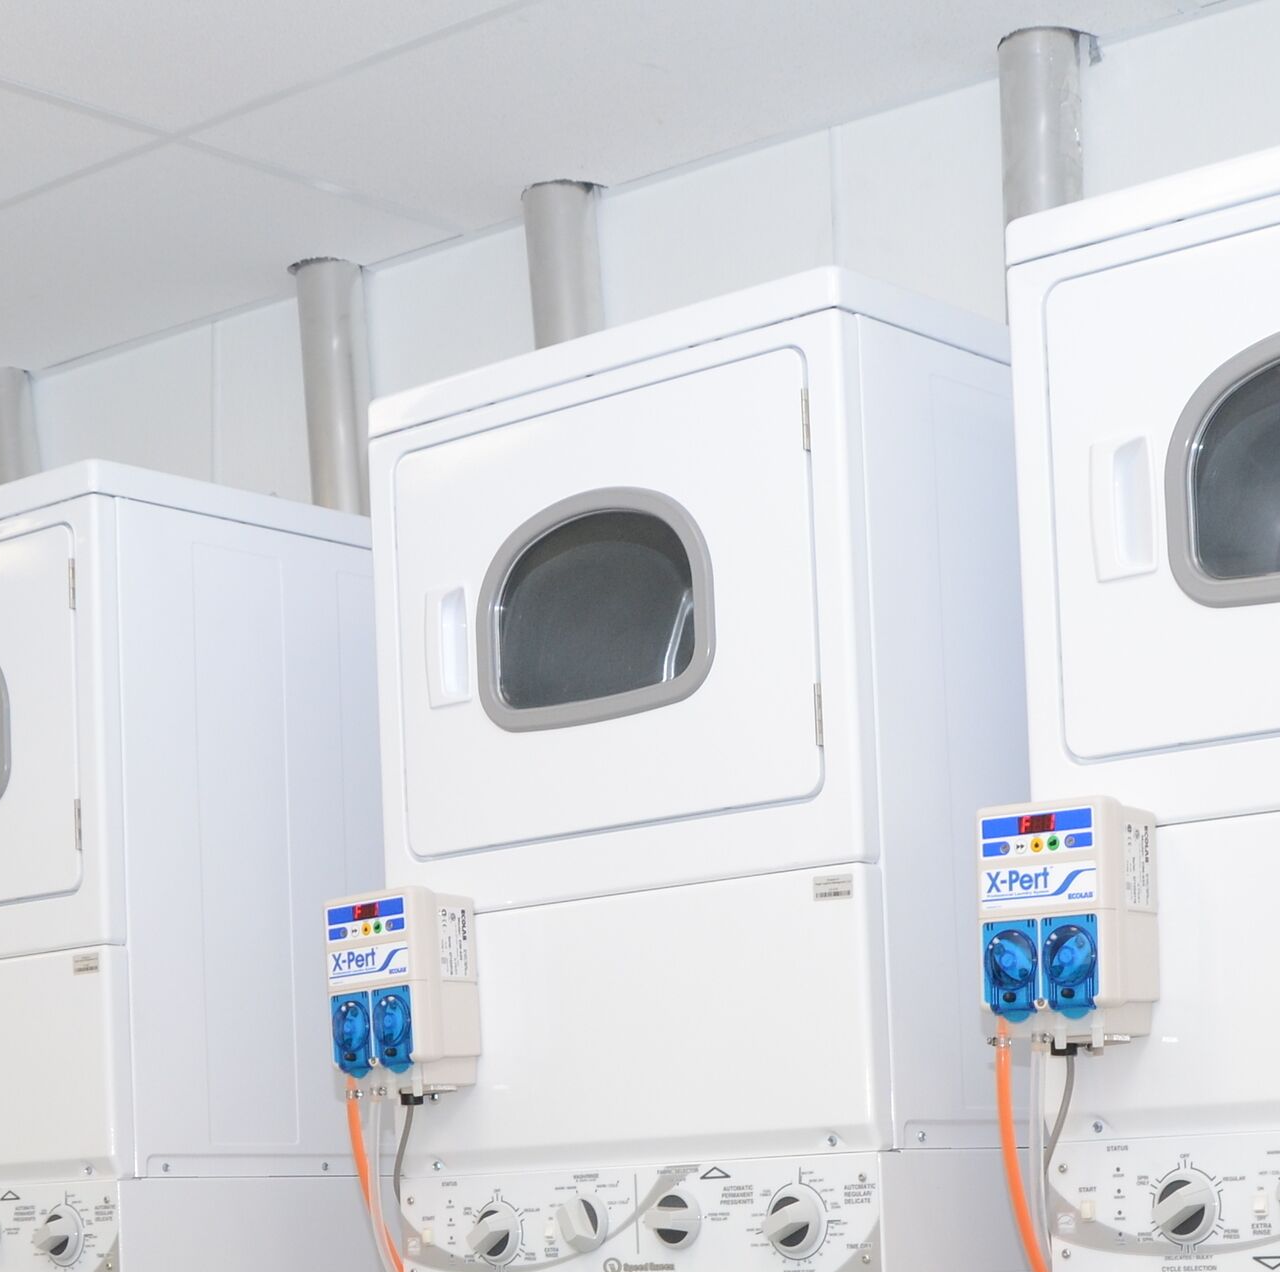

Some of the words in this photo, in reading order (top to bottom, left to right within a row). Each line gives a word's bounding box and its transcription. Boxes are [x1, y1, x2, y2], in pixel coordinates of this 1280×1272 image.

[986, 867, 1049, 894] X-Pert
[1068, 891, 1094, 900] ECOLAB
[332, 947, 376, 972] X-Pert
